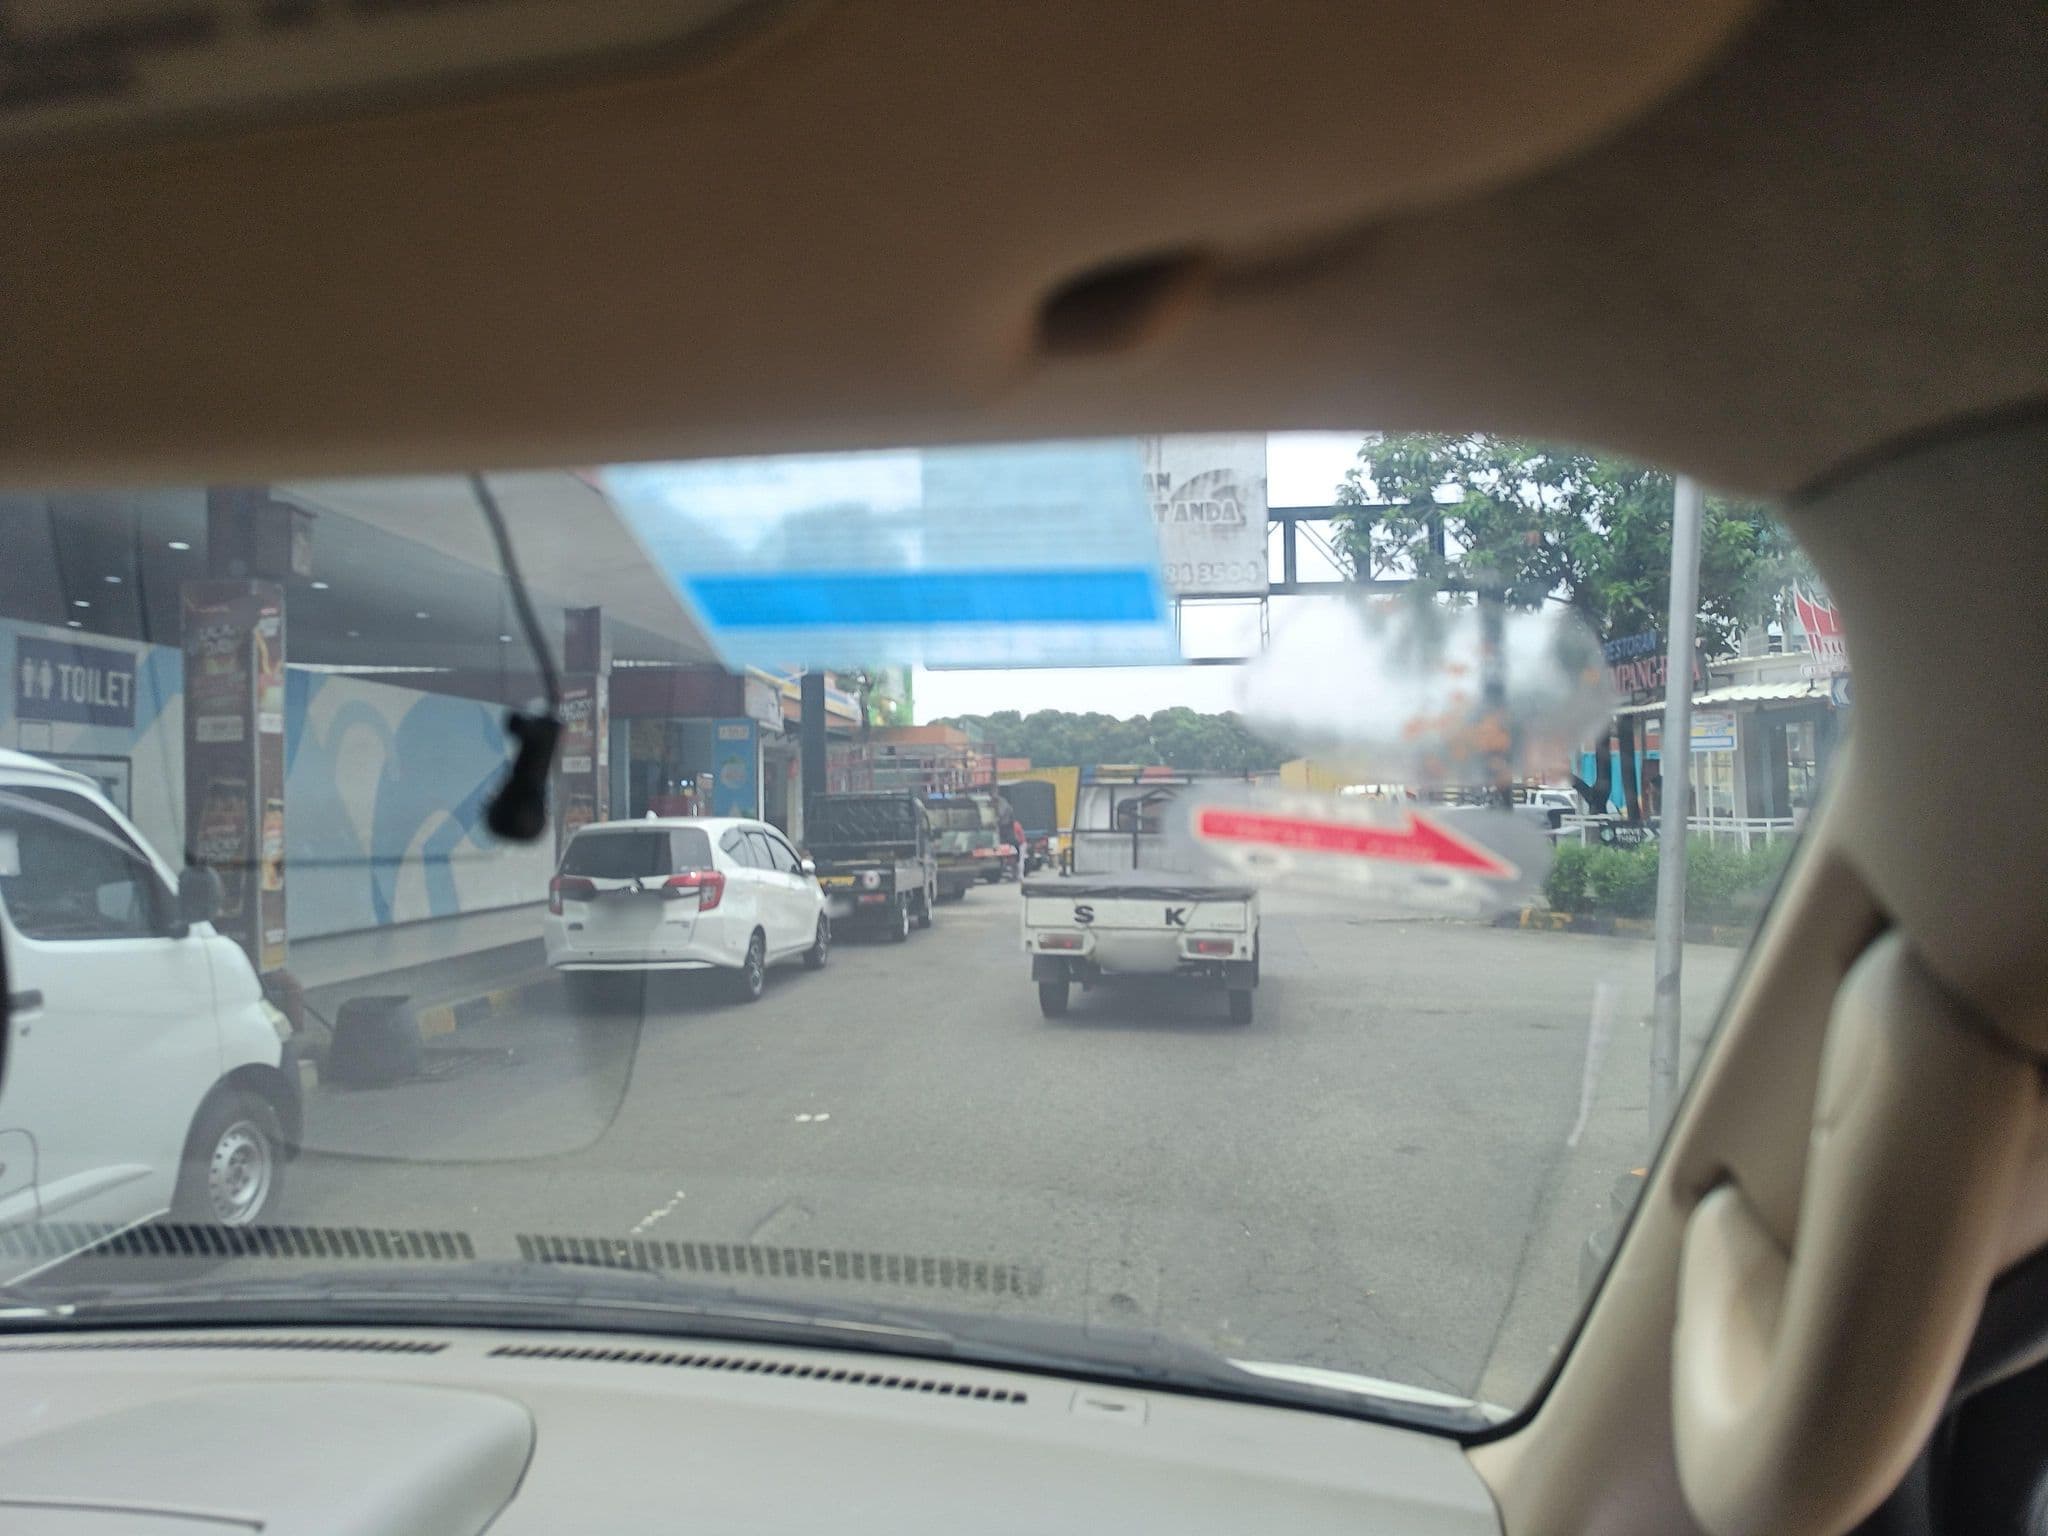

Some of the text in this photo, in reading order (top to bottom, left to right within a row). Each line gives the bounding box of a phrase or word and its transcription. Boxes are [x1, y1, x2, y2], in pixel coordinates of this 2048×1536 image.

[1174, 501, 1236, 522] ANDA
[58, 663, 133, 708] TOILET
[1074, 906, 1186, 926] S K
